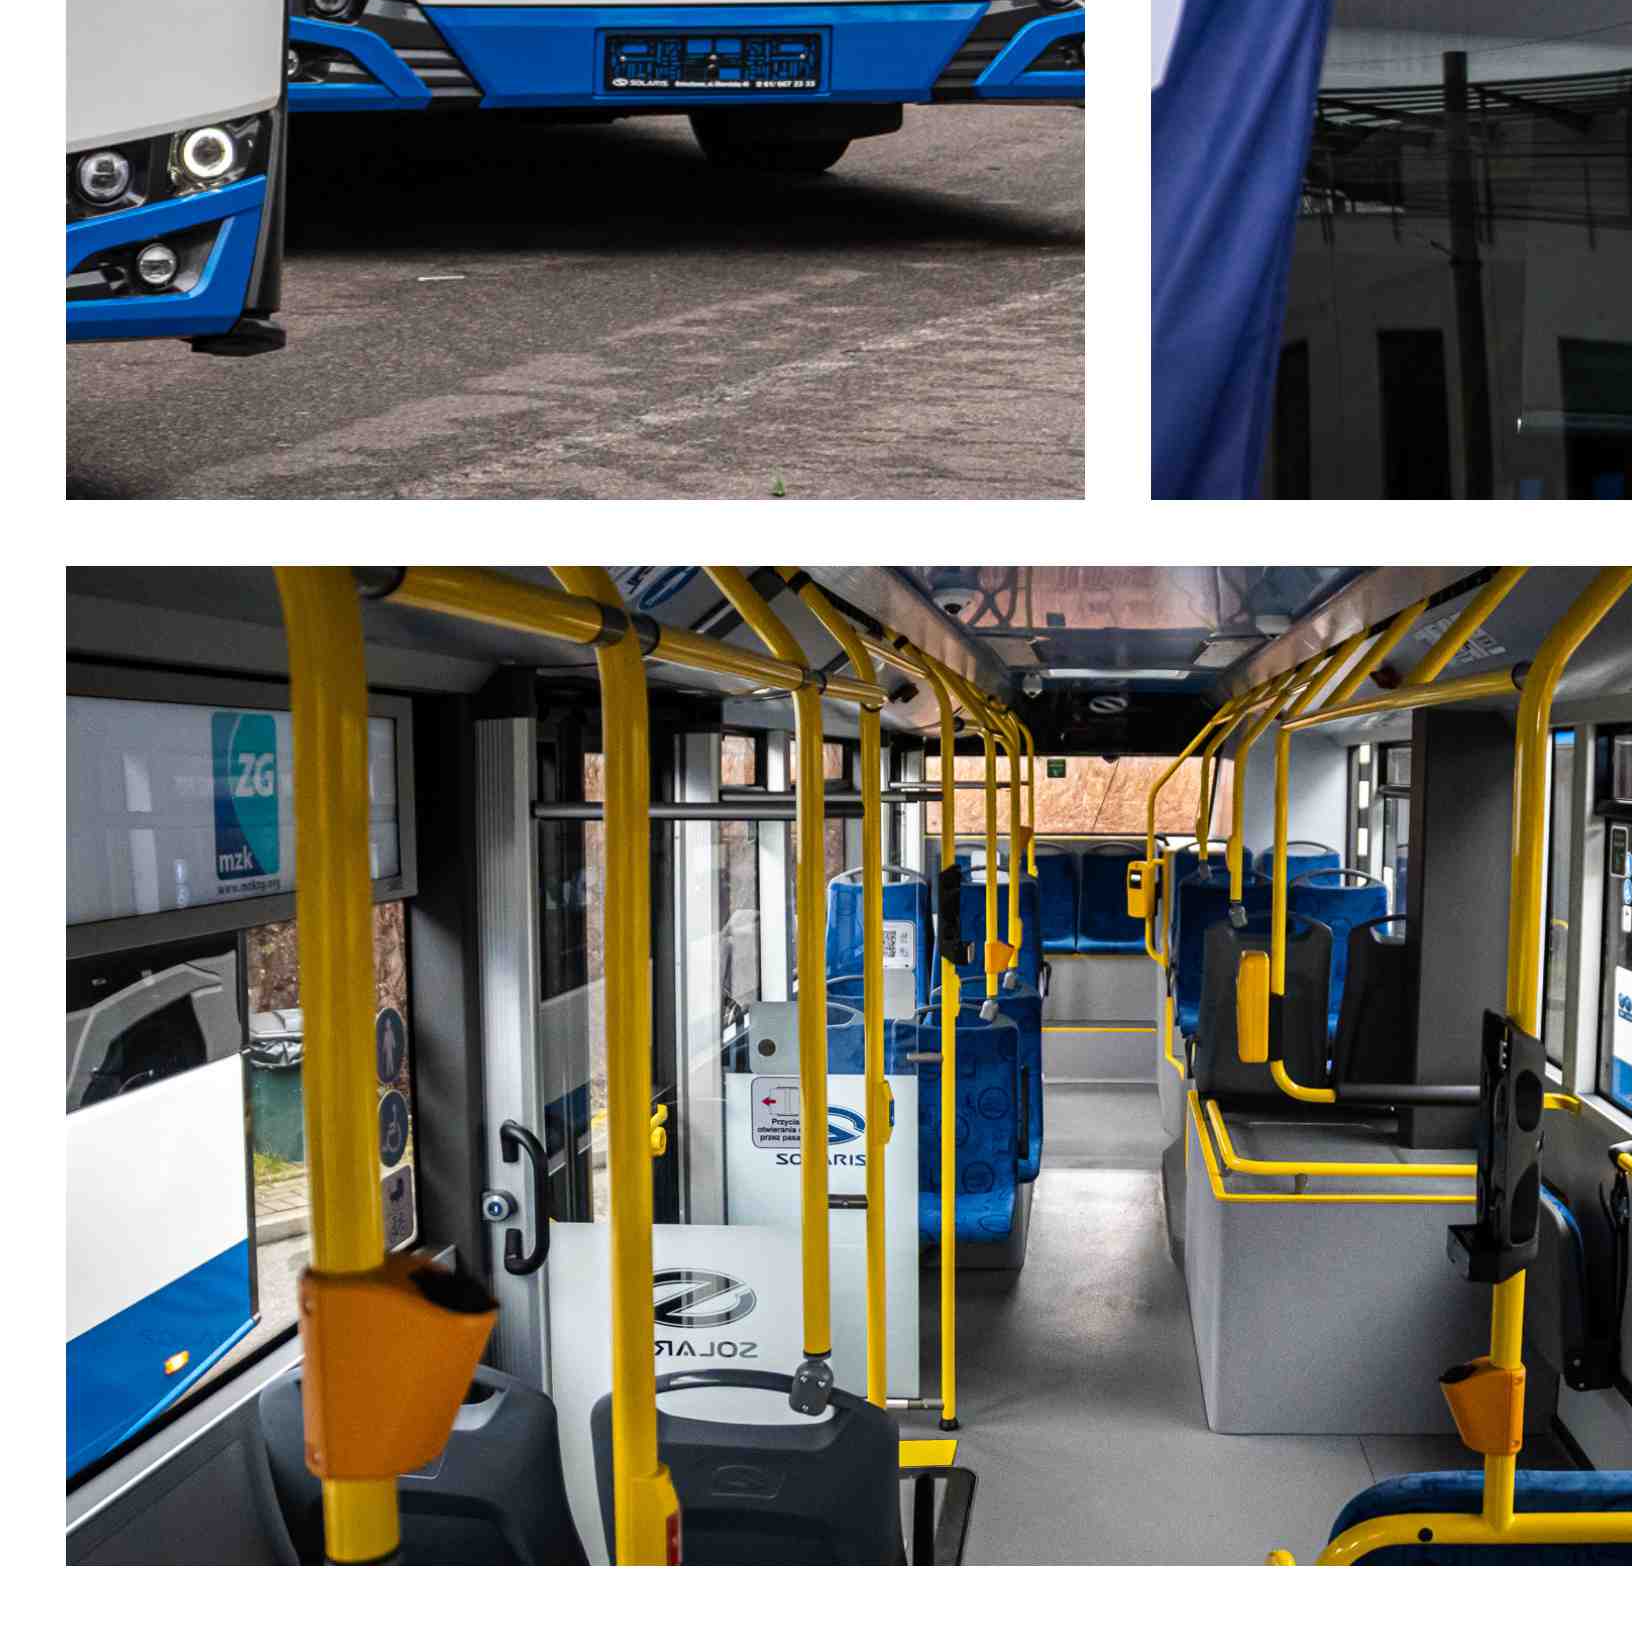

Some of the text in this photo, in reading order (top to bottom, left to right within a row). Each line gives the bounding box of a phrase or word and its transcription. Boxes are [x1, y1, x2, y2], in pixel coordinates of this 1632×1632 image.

[235, 752, 275, 798] ZG
[218, 844, 255, 873] mzk
[771, 1118, 801, 1127] Przycis
[776, 1152, 867, 1167] SORIS
